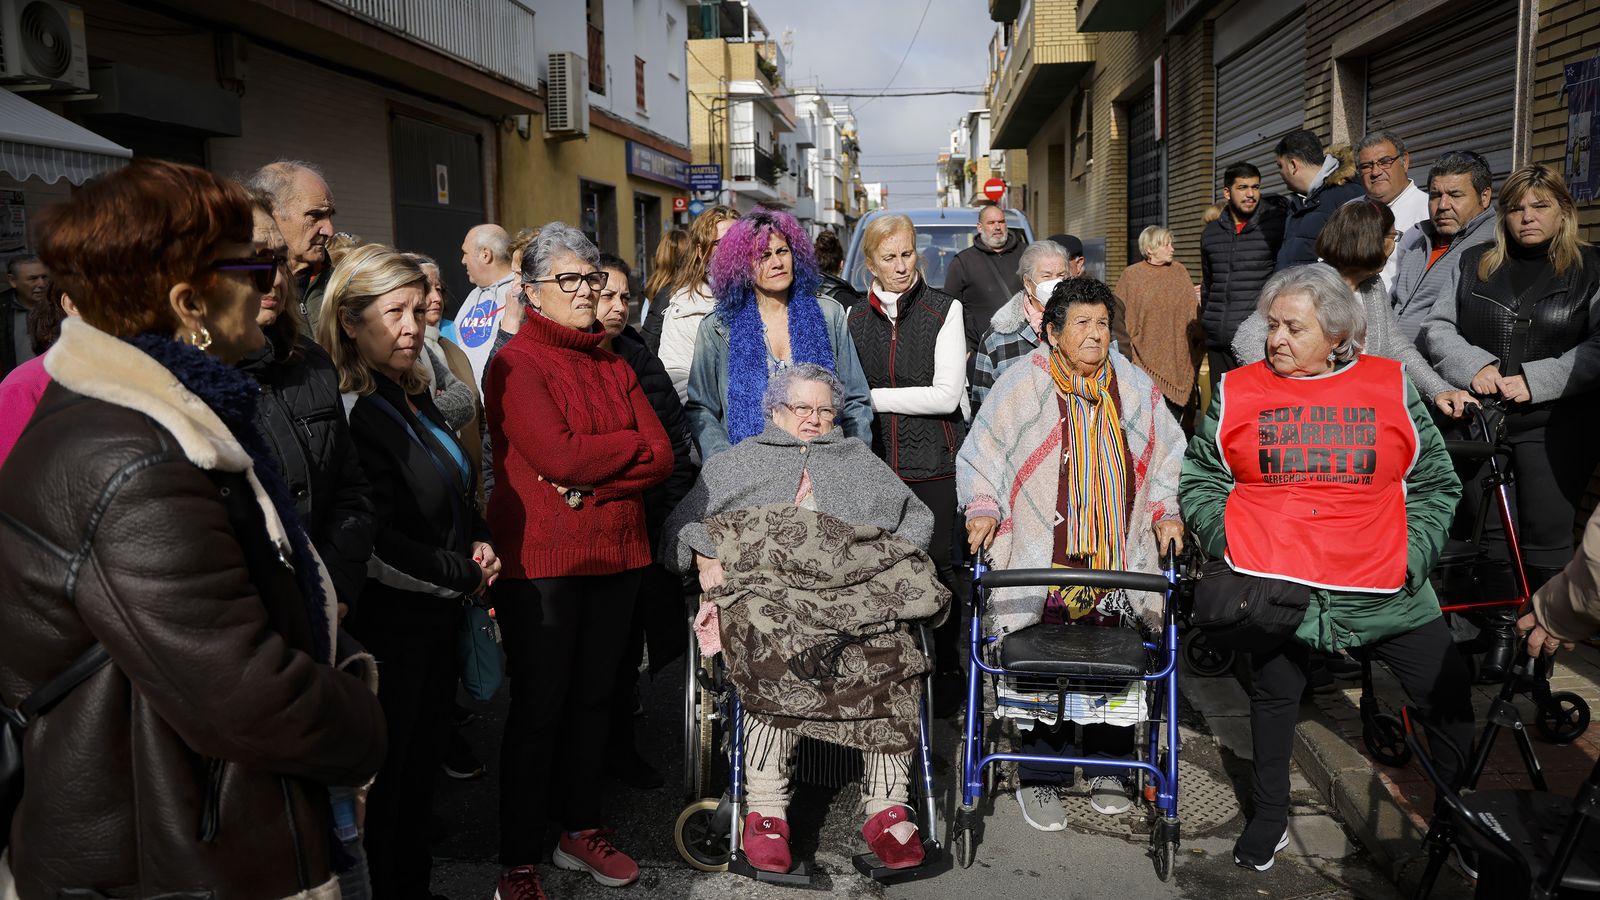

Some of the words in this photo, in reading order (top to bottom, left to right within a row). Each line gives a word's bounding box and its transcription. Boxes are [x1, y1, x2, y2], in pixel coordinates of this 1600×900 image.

[691, 166, 718, 174] MARTELL
[461, 317, 492, 328] NASA
[1258, 406, 1304, 423] SOY
[1310, 406, 1338, 422] DE
[1343, 407, 1376, 422] UN
[1259, 424, 1376, 446] BARRIO
[1259, 448, 1376, 474] HARTO
[1316, 474, 1360, 484] DIGNIDAD
[1361, 475, 1374, 485] YA!
